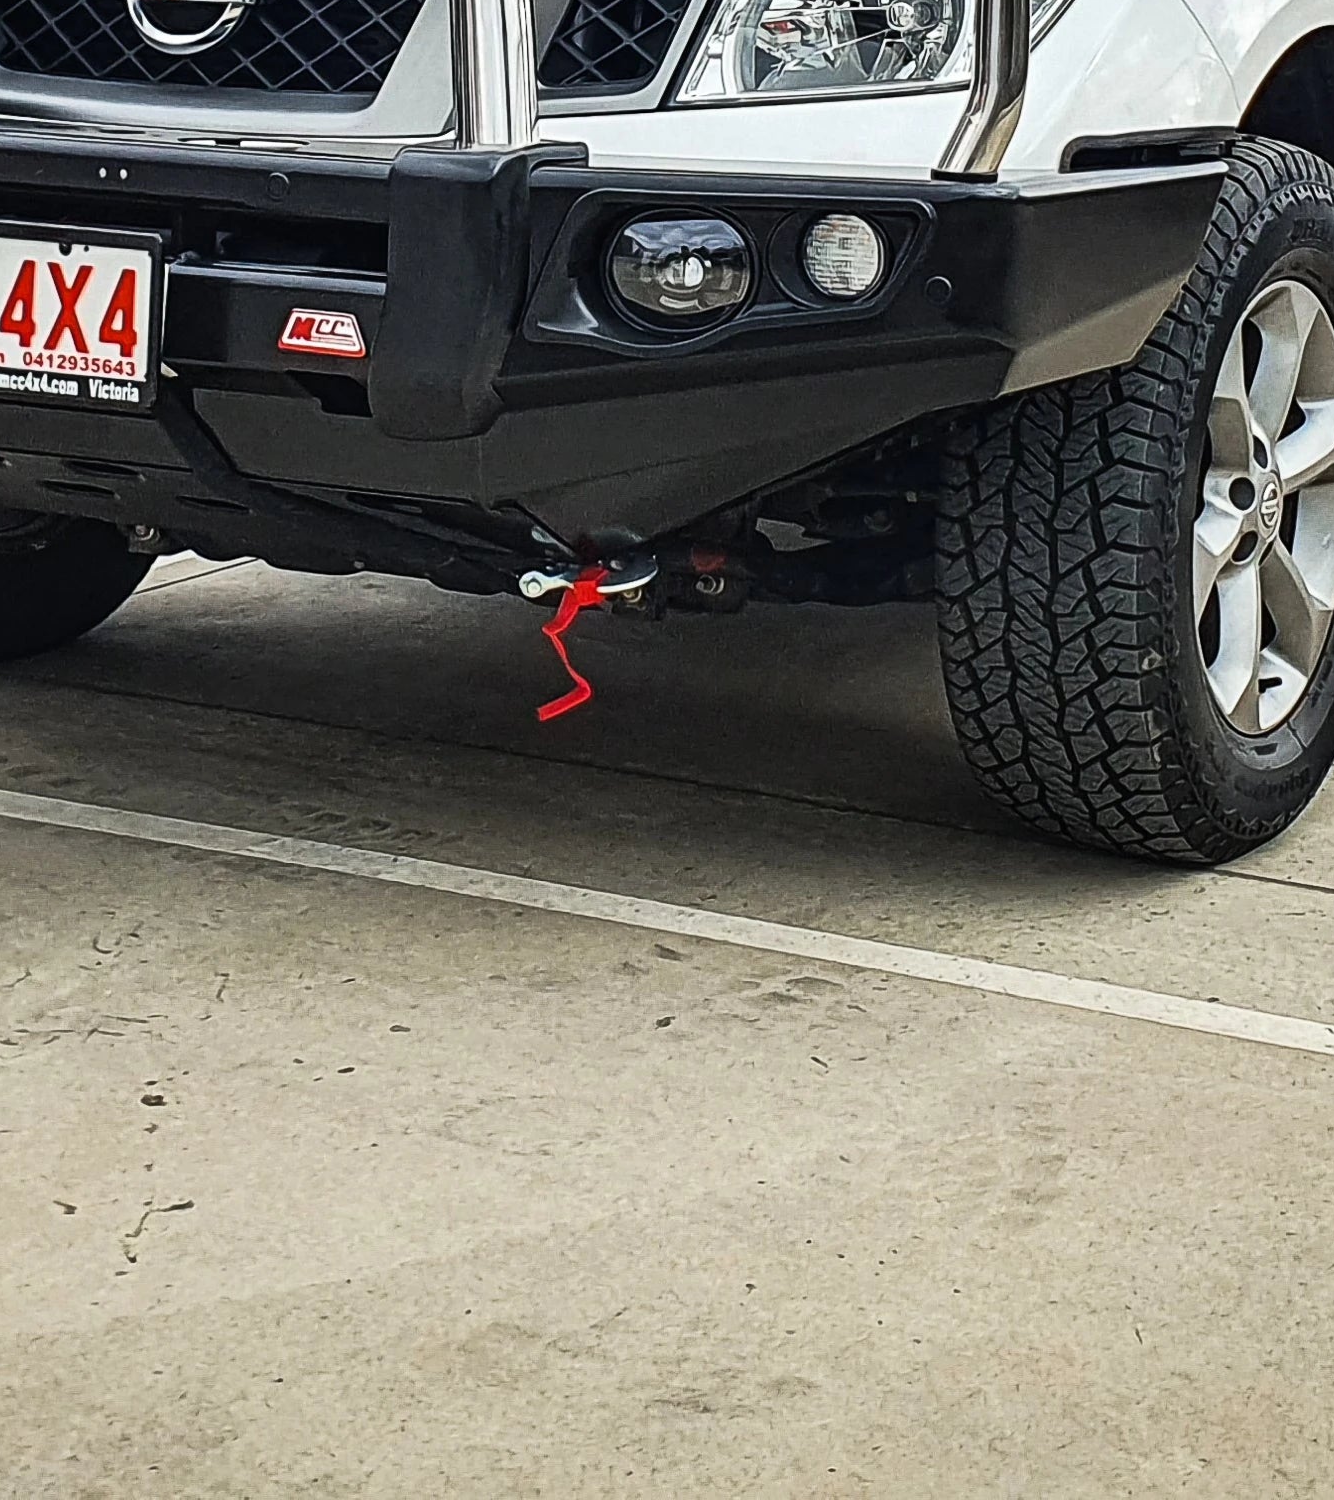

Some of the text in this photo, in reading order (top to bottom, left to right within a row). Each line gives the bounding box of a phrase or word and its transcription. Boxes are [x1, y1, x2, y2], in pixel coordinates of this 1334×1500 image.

[287, 316, 352, 340] MCC
[22, 351, 136, 377] 0412935643
[88, 378, 139, 403] Victoria
